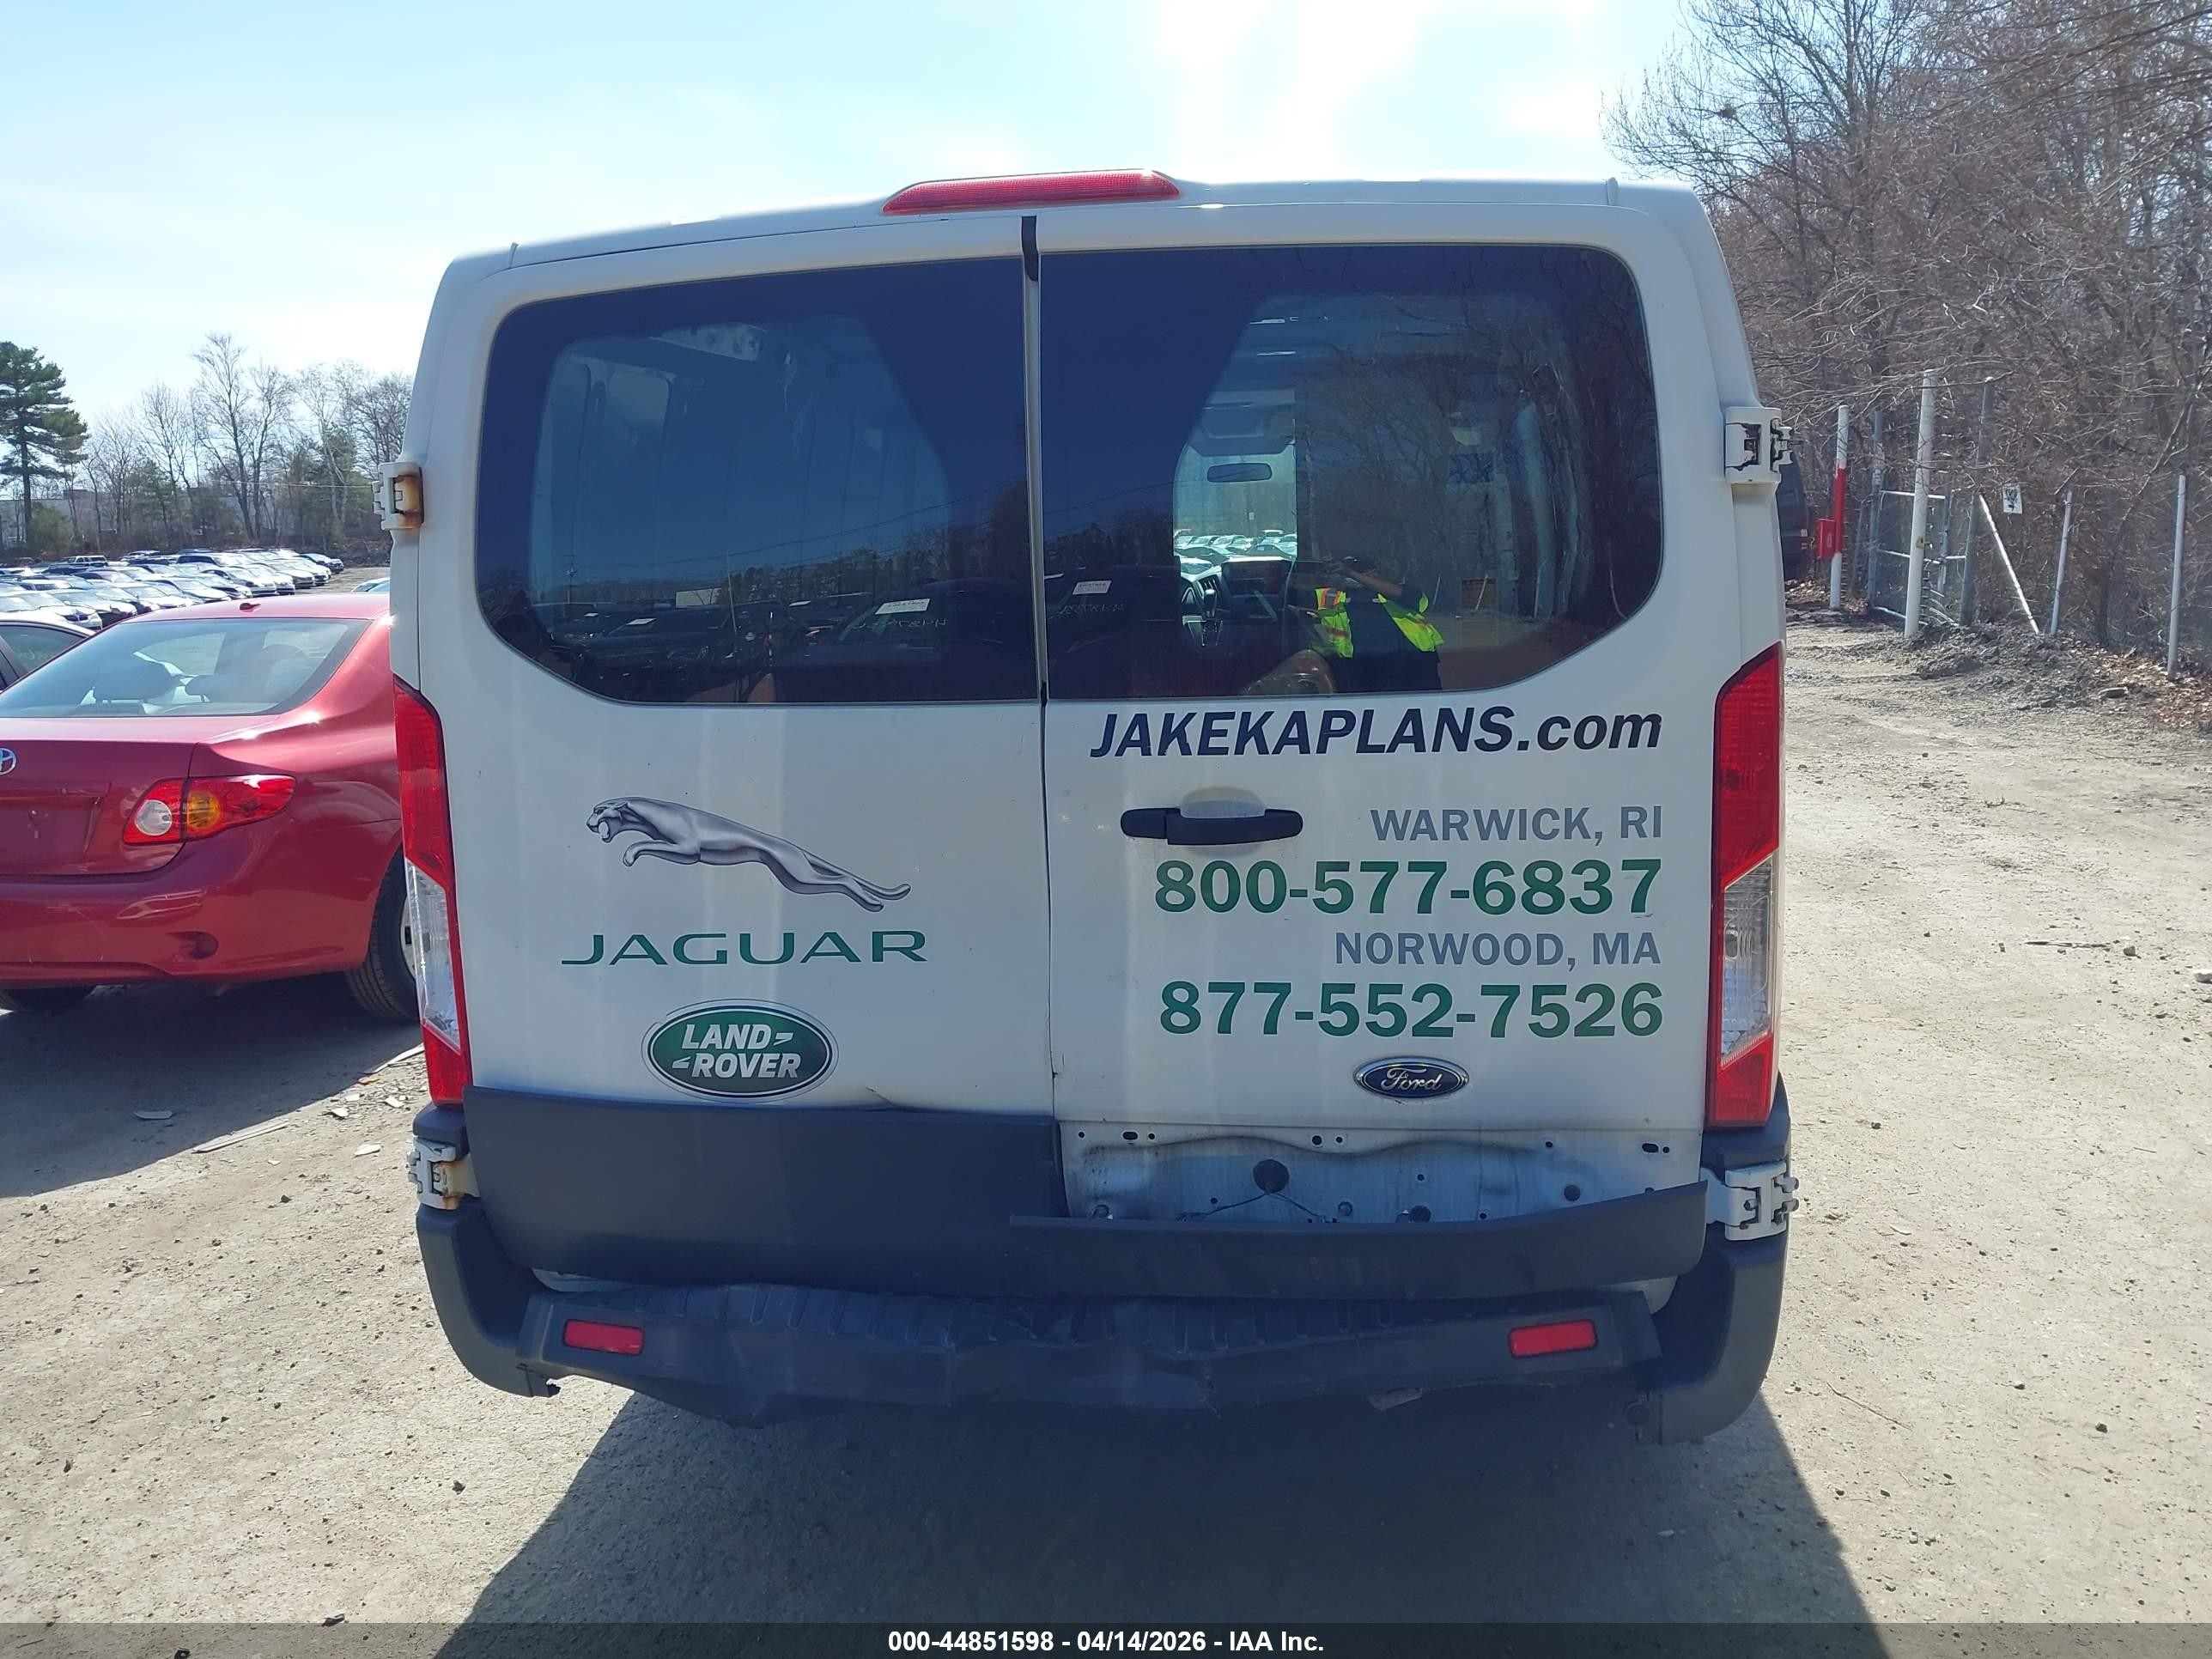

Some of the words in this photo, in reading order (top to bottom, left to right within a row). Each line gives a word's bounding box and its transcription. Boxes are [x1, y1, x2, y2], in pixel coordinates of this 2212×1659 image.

[1090, 706, 1662, 758] JAKEKAPLANS.com
[1370, 808, 1604, 847] WARWICK,
[1620, 806, 1662, 839] RI
[1154, 859, 1662, 915] 800-577-6837
[562, 930, 927, 966] JAGUAR
[1335, 933, 1577, 971] NORWOOD,
[1592, 933, 1661, 964] MA
[1160, 981, 1663, 1038] 877-552-7526
[682, 1024, 772, 1049] LAND
[691, 1053, 801, 1079] ROVER
[1380, 1067, 1443, 1091] Ford
